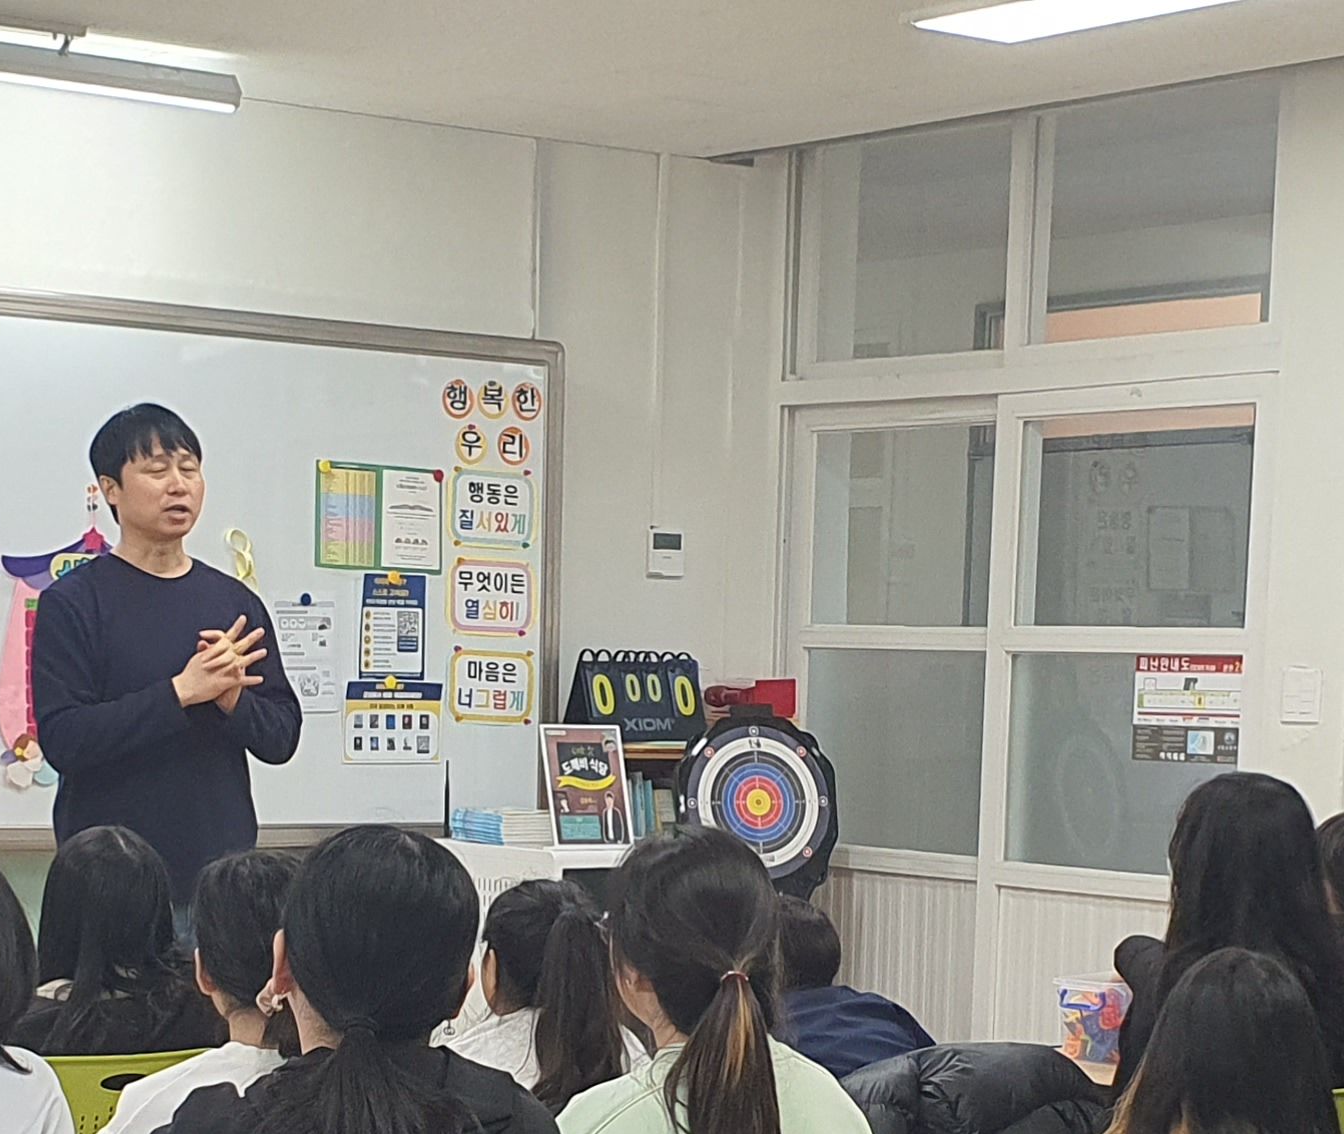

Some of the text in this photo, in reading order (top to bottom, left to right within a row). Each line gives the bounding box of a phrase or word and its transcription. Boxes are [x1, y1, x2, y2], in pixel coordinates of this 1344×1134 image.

[468, 481, 519, 506] 행동은
[458, 508, 526, 535] 질서있게
[458, 570, 526, 594] 무엇이든
[467, 660, 518, 683] 마음은
[457, 688, 524, 711] 너그럽게
[623, 717, 672, 732] XIOM
